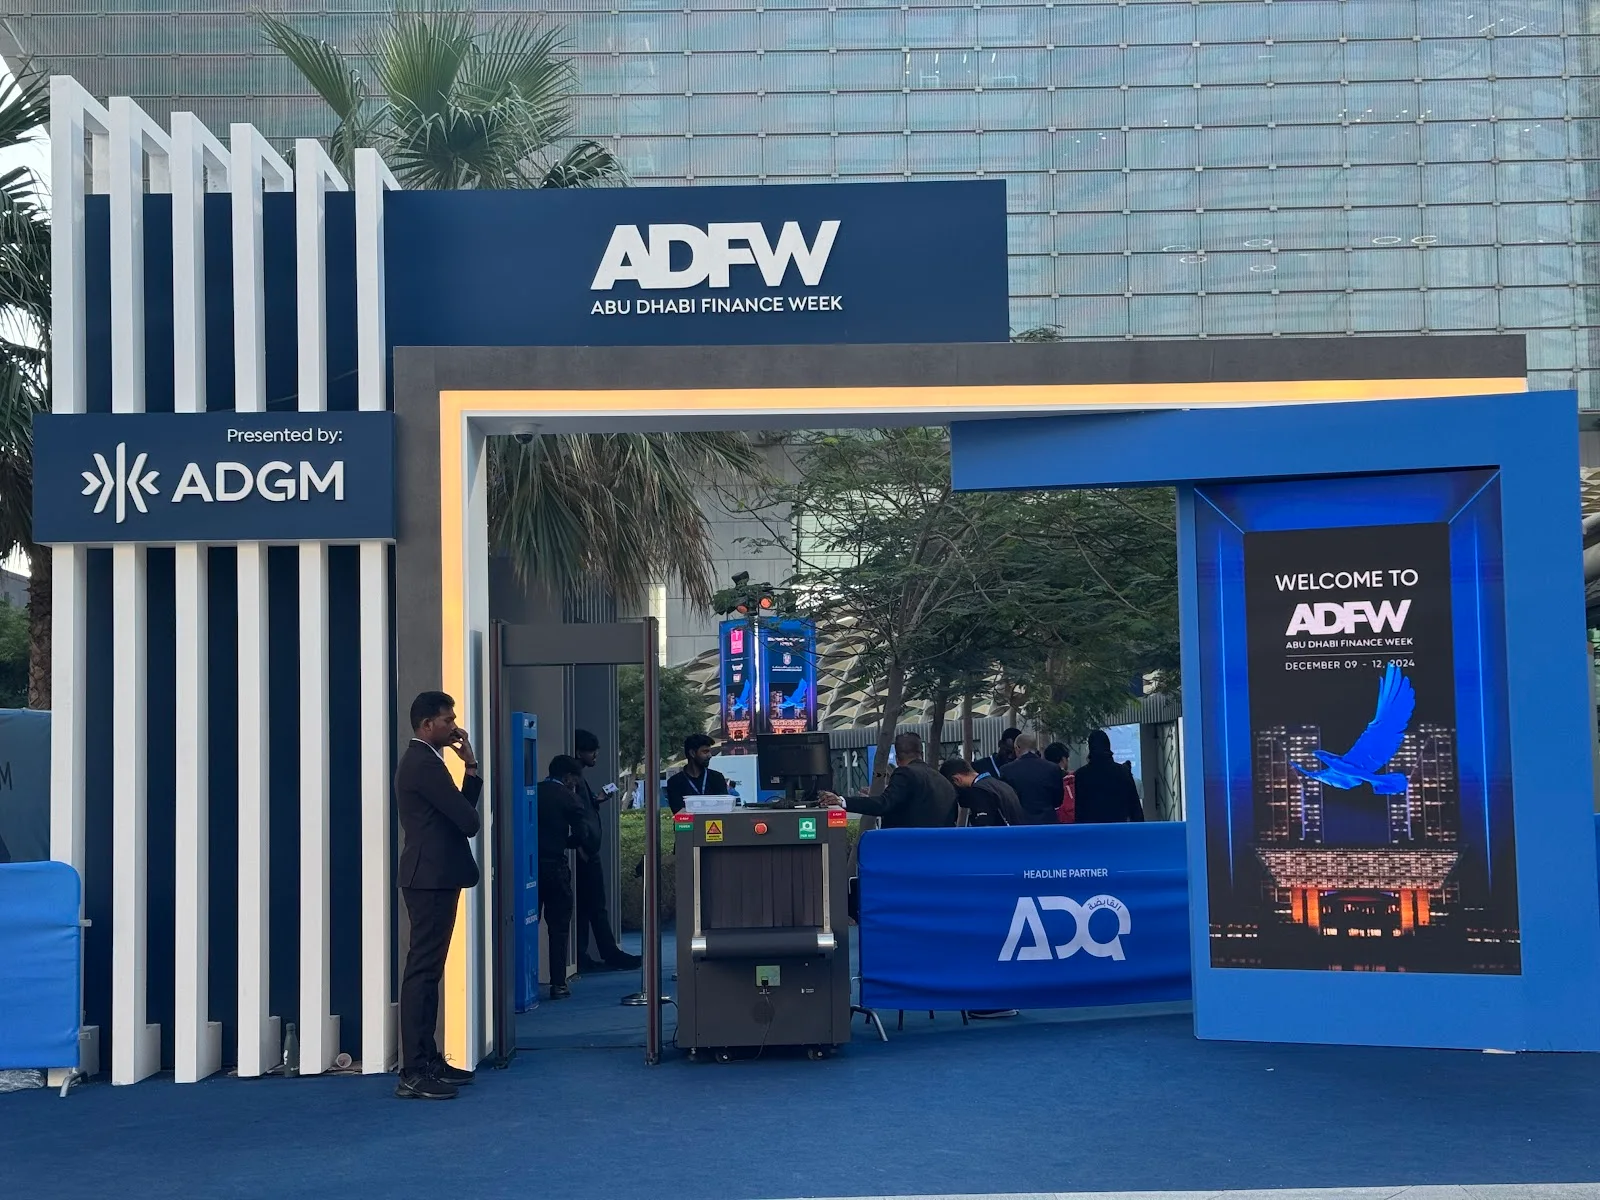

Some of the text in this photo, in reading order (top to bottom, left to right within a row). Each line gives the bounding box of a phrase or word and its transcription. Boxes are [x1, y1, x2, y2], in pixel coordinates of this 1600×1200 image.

[590, 220, 841, 290] ADFW
[590, 295, 843, 315] ABU DHABI FINANCE WEEK
[227, 428, 343, 444] Presented by:
[171, 460, 344, 502] ADGM
[1275, 569, 1419, 591] WELCOME TO
[1285, 599, 1412, 636] ADFW
[1285, 637, 1413, 649] ABU DHABI FINANCE WEEK
[1285, 661, 1341, 671] DECEMBER
[1344, 661, 1358, 669] 09
[1390, 659, 1415, 668] 2024
[1023, 868, 1108, 879] HEADLINE PARTNER
[998, 894, 1131, 961] ADQ
